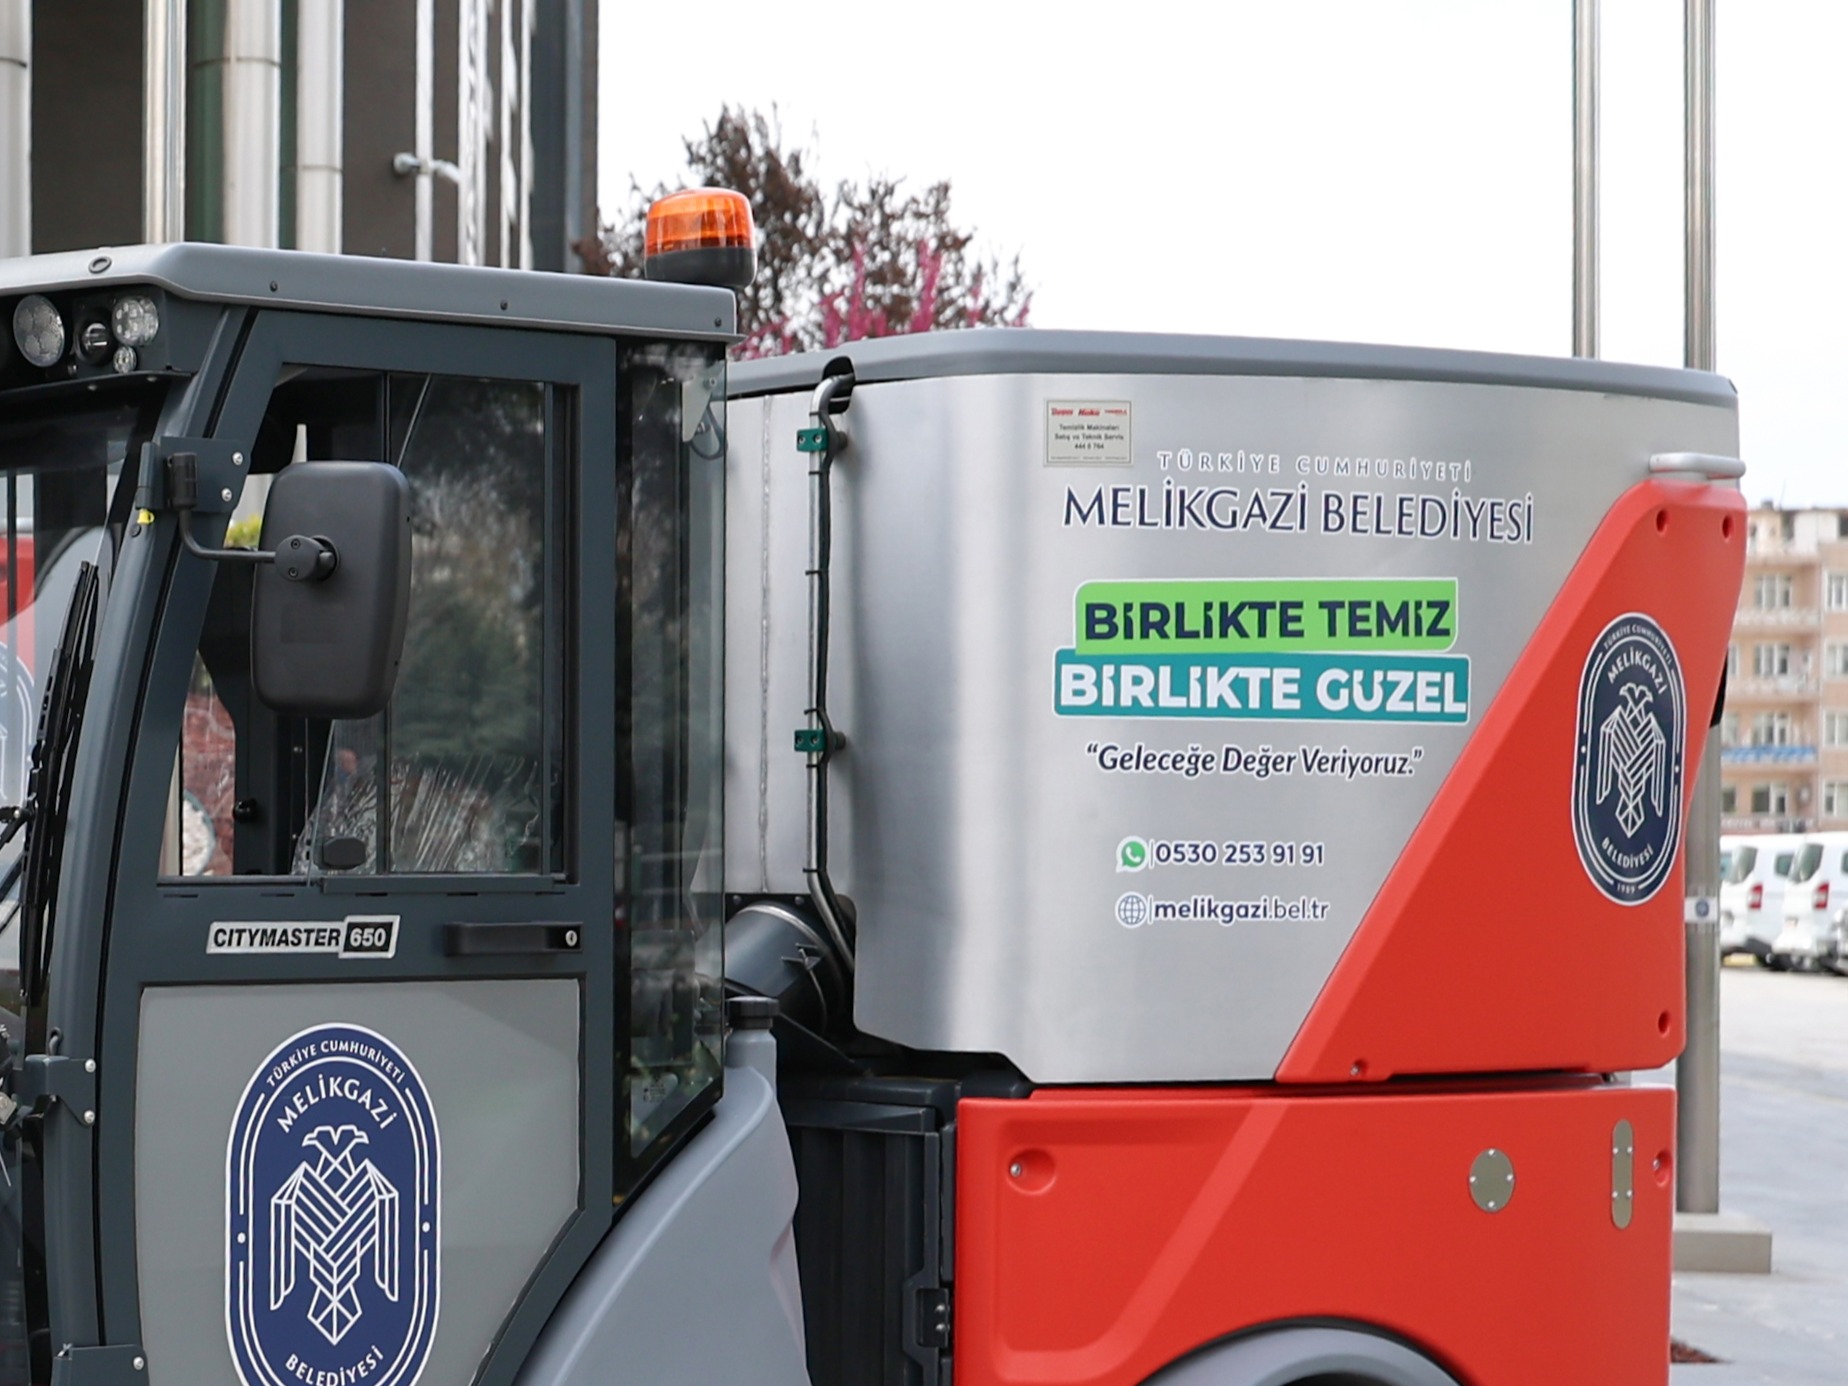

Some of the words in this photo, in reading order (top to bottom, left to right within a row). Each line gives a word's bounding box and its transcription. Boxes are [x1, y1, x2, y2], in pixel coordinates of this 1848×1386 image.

[1158, 449, 1280, 472] TÜRKİYE
[1296, 456, 1473, 482] CUMHURİYETİ
[1064, 477, 1307, 531] MELİKGAZİ
[1322, 488, 1533, 543] BELEDİYESİ
[1608, 646, 1668, 694] MELİKGAZİ
[1222, 746, 1295, 778] Değer
[1155, 843, 1217, 863] 0530
[1223, 843, 1266, 864] 253
[1272, 843, 1295, 864] 91
[1302, 844, 1324, 865] 91
[1602, 837, 1654, 869] BELEDİYESİ
[1155, 897, 1329, 924] melikgazi.bel.tr
[214, 928, 341, 948] CITYMASTER
[350, 928, 386, 947] 650
[266, 1043, 318, 1086] TÜRKİYE
[320, 1039, 406, 1083] CUMHURİYETİ
[276, 1074, 398, 1133] MELİKGAZİ
